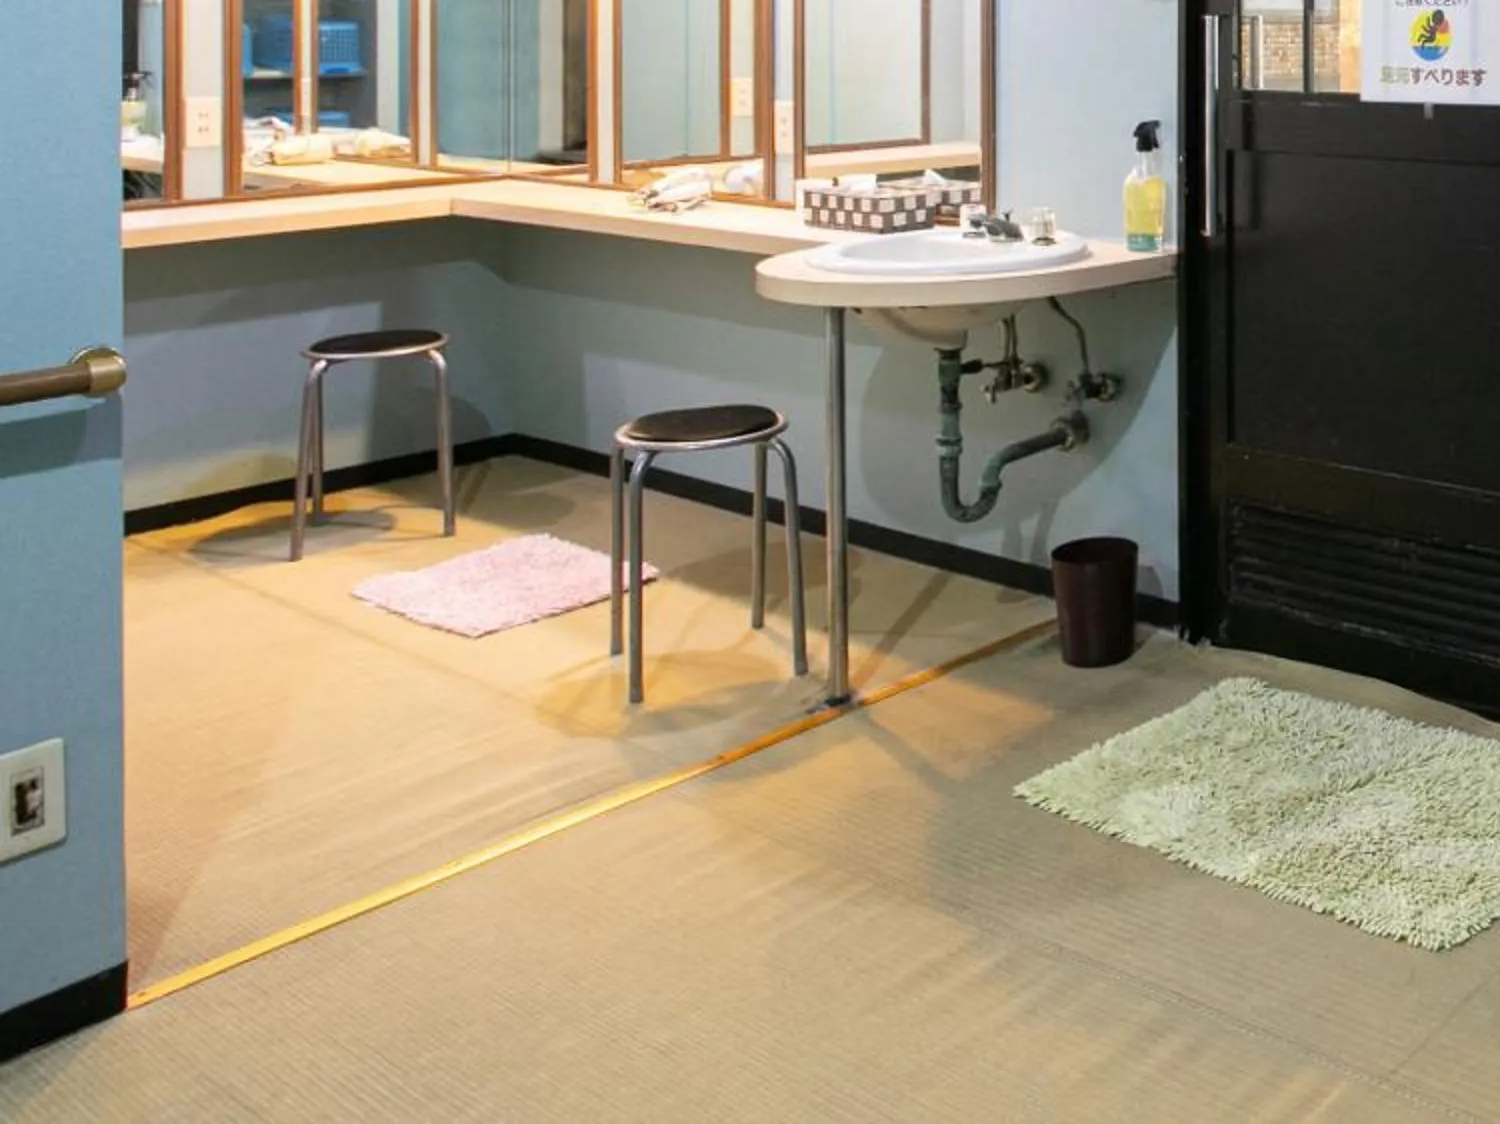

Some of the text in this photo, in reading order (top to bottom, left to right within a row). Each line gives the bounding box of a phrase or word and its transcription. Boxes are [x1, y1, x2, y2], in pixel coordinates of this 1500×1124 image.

[1379, 65, 1487, 87] 足元すべります
